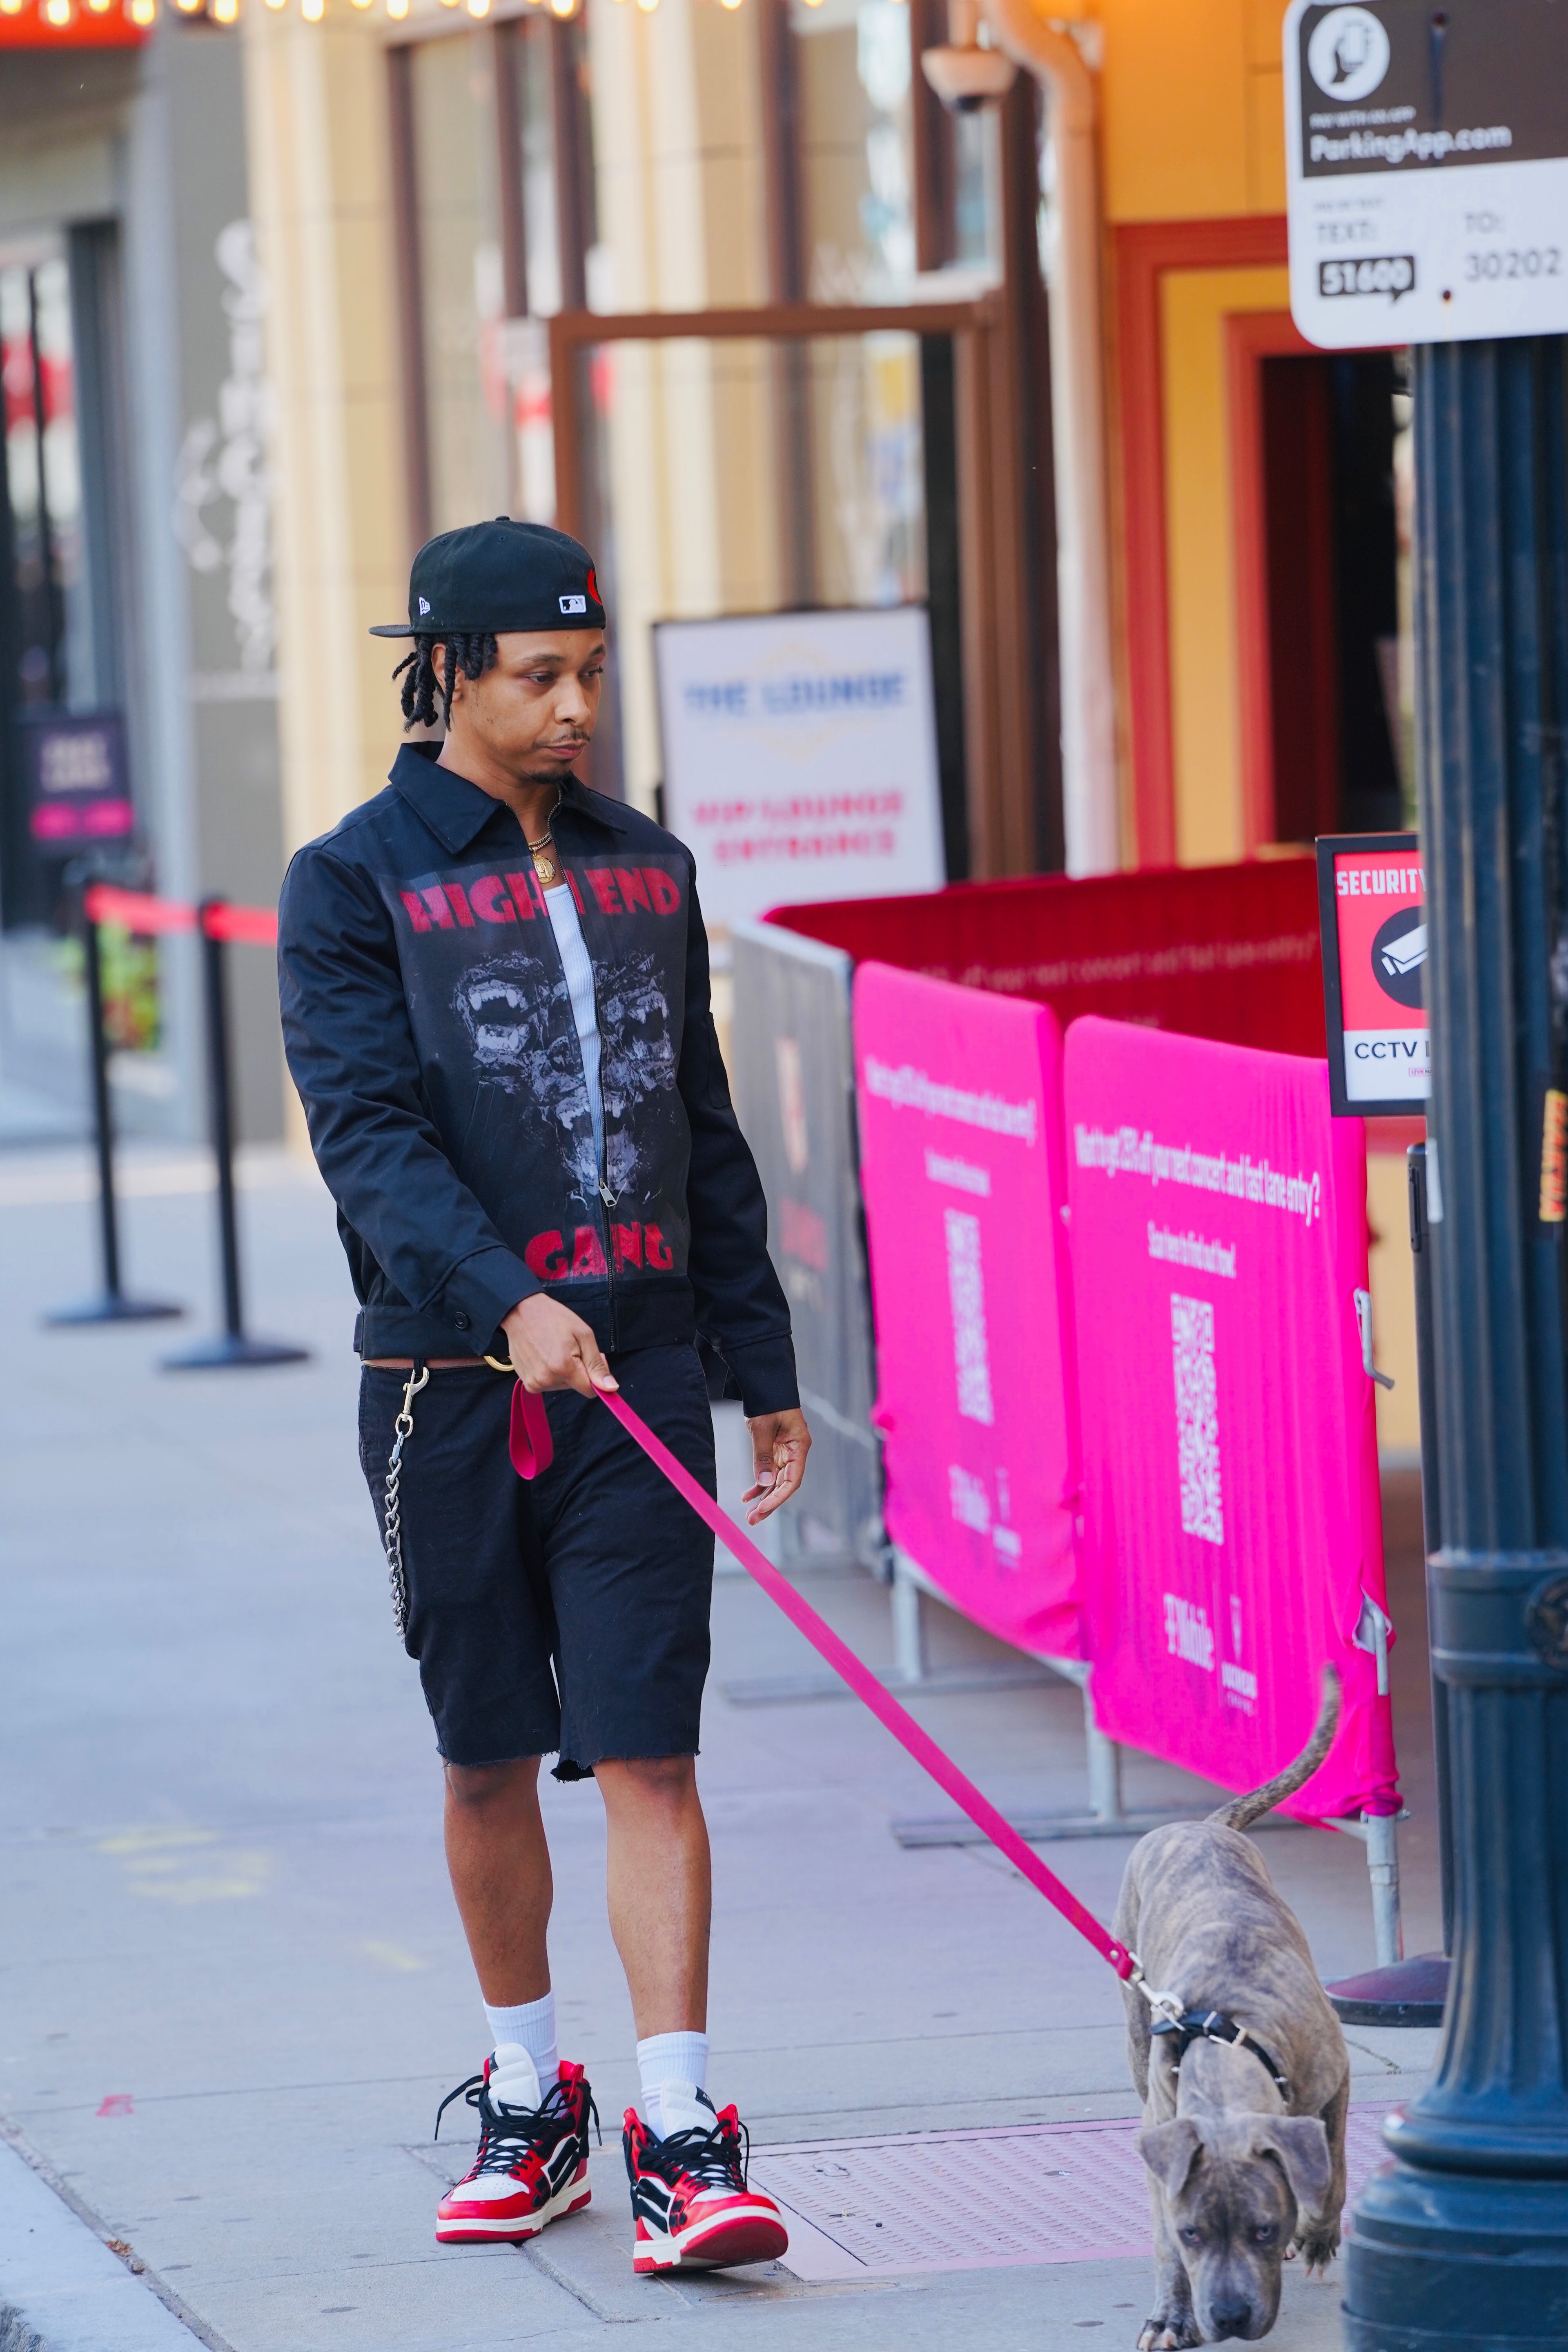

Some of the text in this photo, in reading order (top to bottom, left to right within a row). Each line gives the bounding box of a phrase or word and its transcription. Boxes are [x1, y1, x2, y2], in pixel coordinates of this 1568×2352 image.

[1310, 127, 1512, 164] ParkingApp.com
[1322, 257, 1412, 295] 51600
[1465, 247, 1561, 283] 30202
[399, 867, 681, 933] HIGH END
[1355, 1042, 1417, 1059] CCTV
[1245, 1154, 1264, 1203] fast
[1264, 1158, 1286, 1208] lane
[1287, 1171, 1320, 1226] entry?
[525, 1221, 674, 1280] GANG
